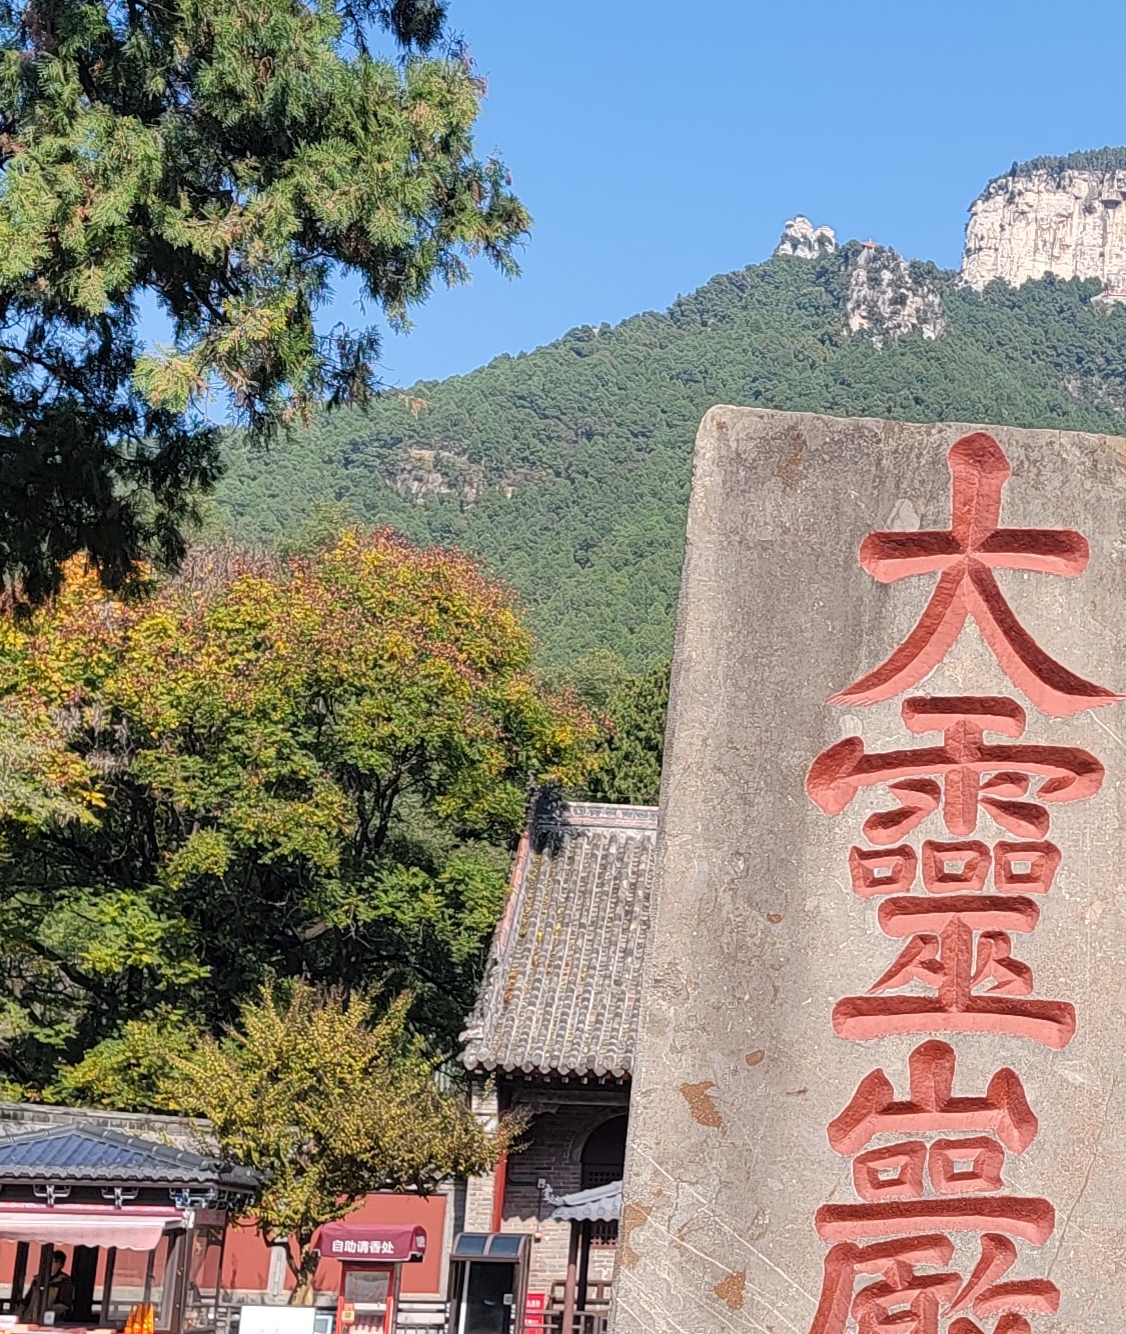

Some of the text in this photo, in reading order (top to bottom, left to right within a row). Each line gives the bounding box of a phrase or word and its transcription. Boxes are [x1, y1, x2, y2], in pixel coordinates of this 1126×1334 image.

[332, 1240, 395, 1254] 自助请香处
